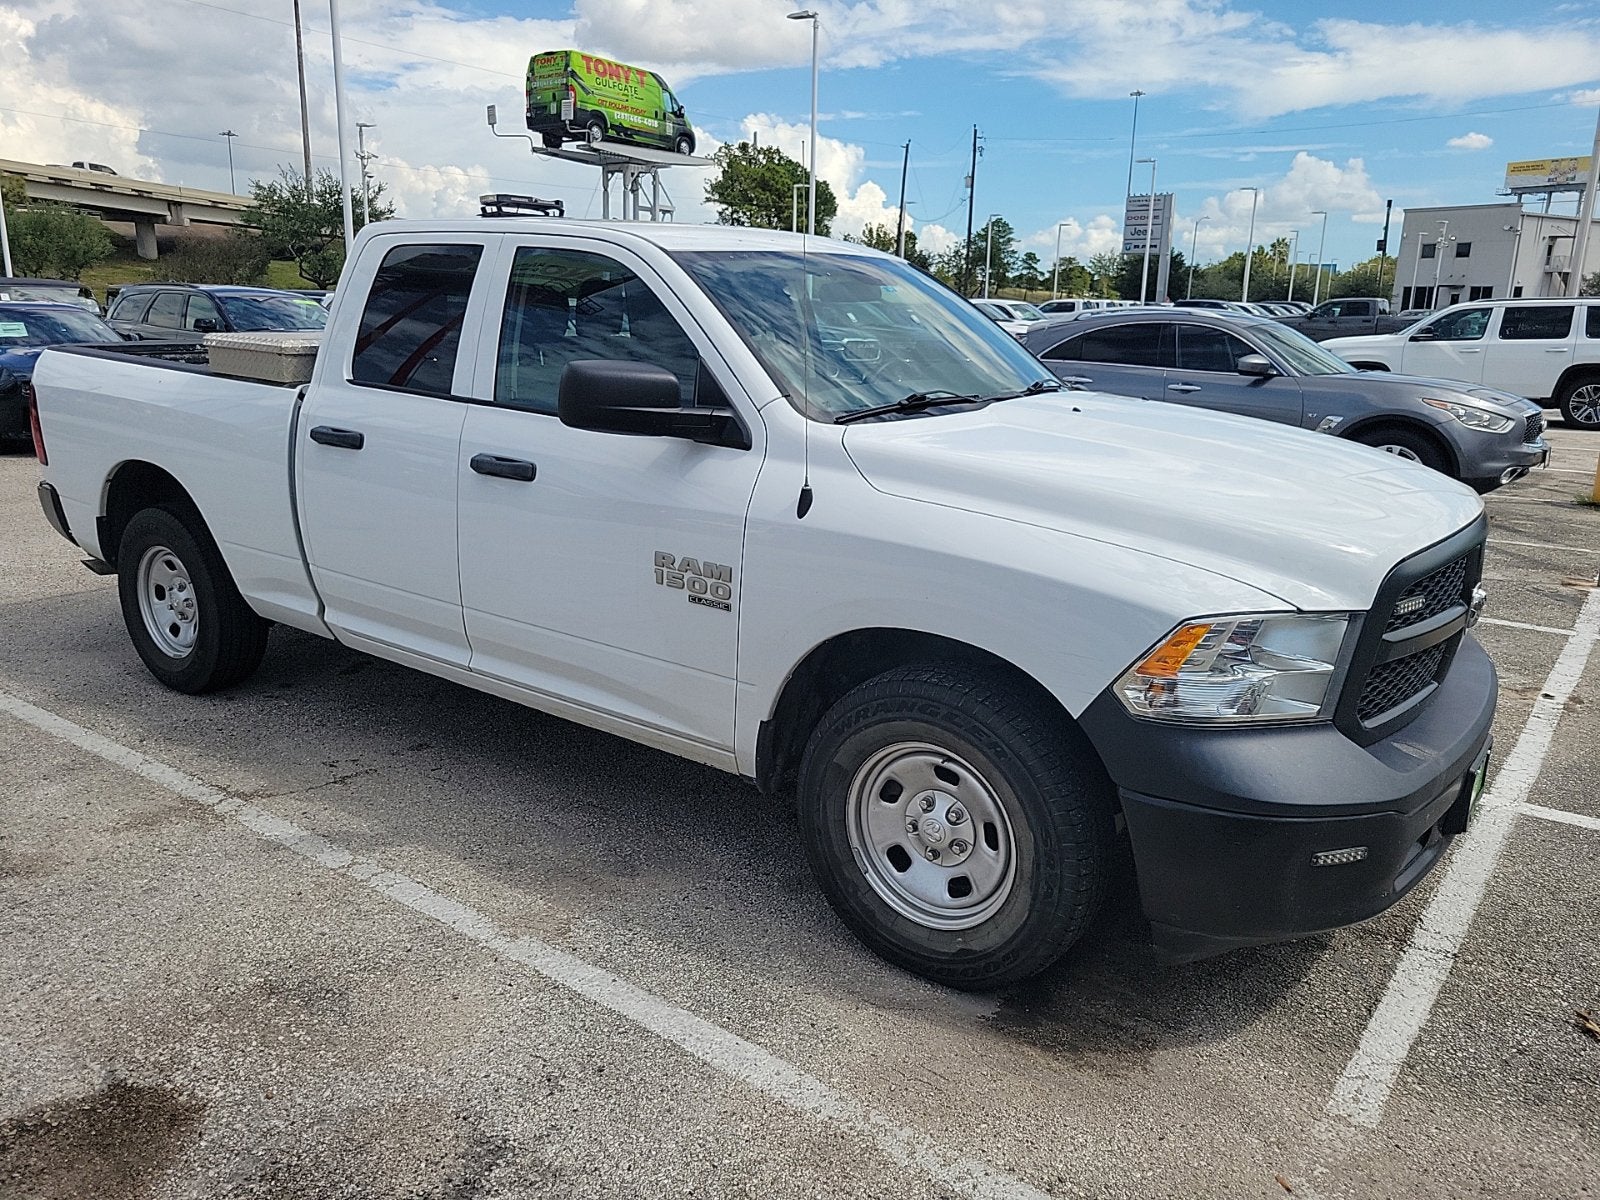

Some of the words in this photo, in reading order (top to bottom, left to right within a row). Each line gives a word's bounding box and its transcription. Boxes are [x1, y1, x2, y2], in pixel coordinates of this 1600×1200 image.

[535, 56, 558, 66] TONY
[559, 54, 566, 62] T
[581, 54, 632, 84] TONY
[634, 69, 648, 88] T
[595, 77, 639, 96] GULFGATE
[608, 101, 630, 111] ROLLING
[630, 107, 647, 115] TODAY
[654, 551, 732, 583] RAM
[654, 568, 732, 601] 1500
[688, 595, 732, 612] CLASSIC
